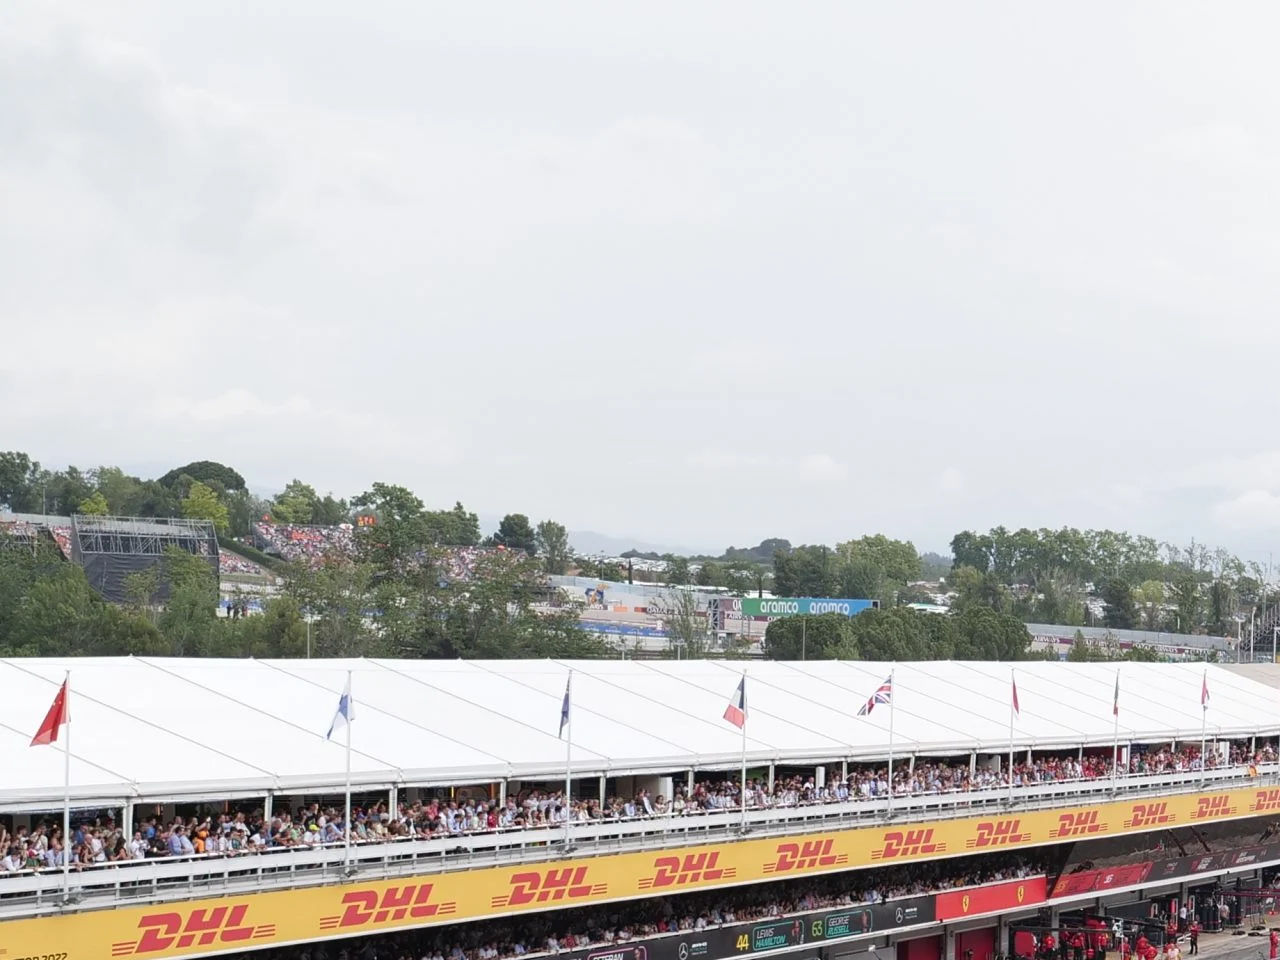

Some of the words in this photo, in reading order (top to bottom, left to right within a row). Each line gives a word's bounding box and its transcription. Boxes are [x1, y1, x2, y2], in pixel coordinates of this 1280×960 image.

[760, 600, 799, 614] aramco
[809, 601, 850, 615] aramco
[1131, 802, 1168, 827] DHL
[1197, 795, 1231, 819] DHL
[975, 819, 1023, 848] DHL
[1057, 810, 1100, 838] DHL
[882, 828, 936, 858] DHL
[775, 839, 837, 872] DHL
[653, 851, 725, 888] DHL
[508, 866, 594, 906] DHL
[339, 884, 439, 928] DHL
[135, 904, 255, 954] DHL
[811, 920, 823, 937] 63
[827, 924, 850, 935] RUSSELL
[828, 915, 850, 927] GEORGE
[736, 934, 750, 951] 44
[755, 934, 787, 949] HAMILTON
[756, 928, 775, 939] LEWIS
